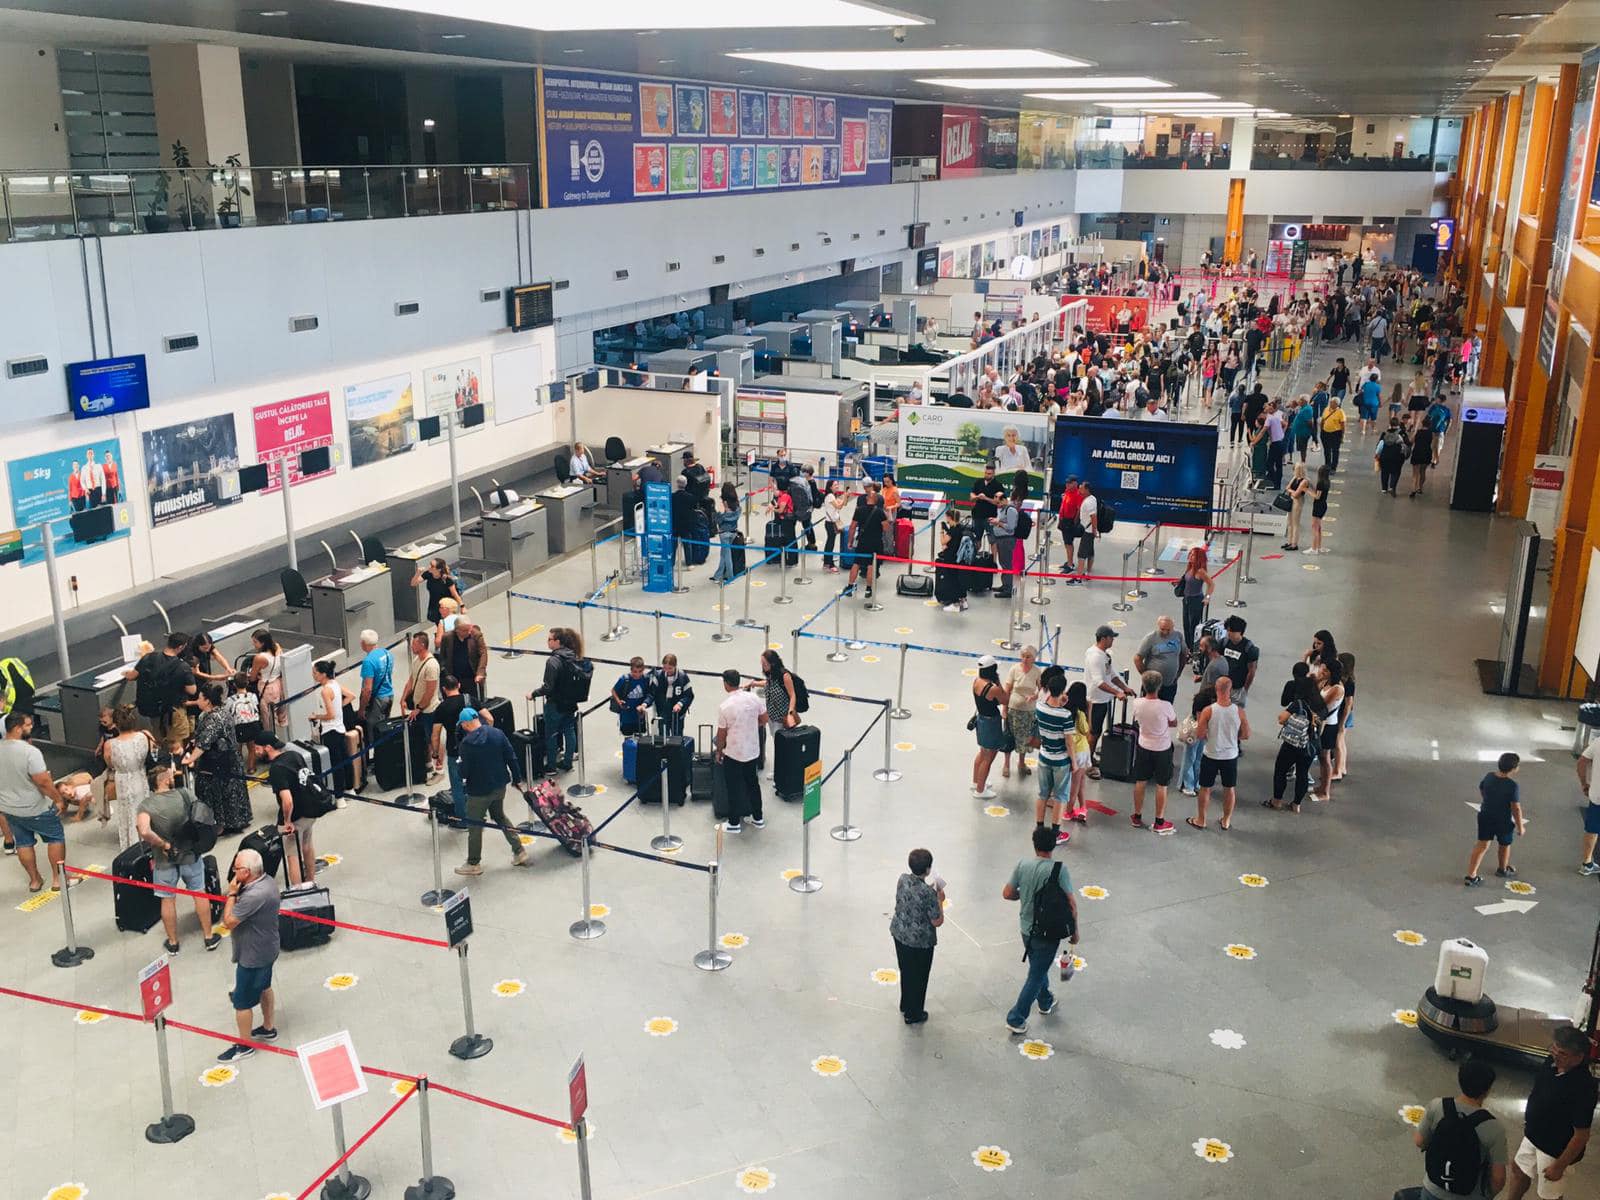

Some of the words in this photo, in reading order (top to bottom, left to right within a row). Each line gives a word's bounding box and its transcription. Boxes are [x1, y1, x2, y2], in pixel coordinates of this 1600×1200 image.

[255, 408, 279, 421] GUSTUL
[313, 397, 327, 407] TALE
[300, 413, 308, 421] LA
[939, 438, 967, 446] premium
[1111, 439, 1145, 450] RECLAMA
[1146, 442, 1155, 450] TA
[1091, 449, 1103, 458] AR
[1126, 452, 1155, 462] GROZAV
[1155, 454, 1170, 464] AICI
[154, 487, 206, 517] #mustvisit
[675, 686, 682, 695] 6
